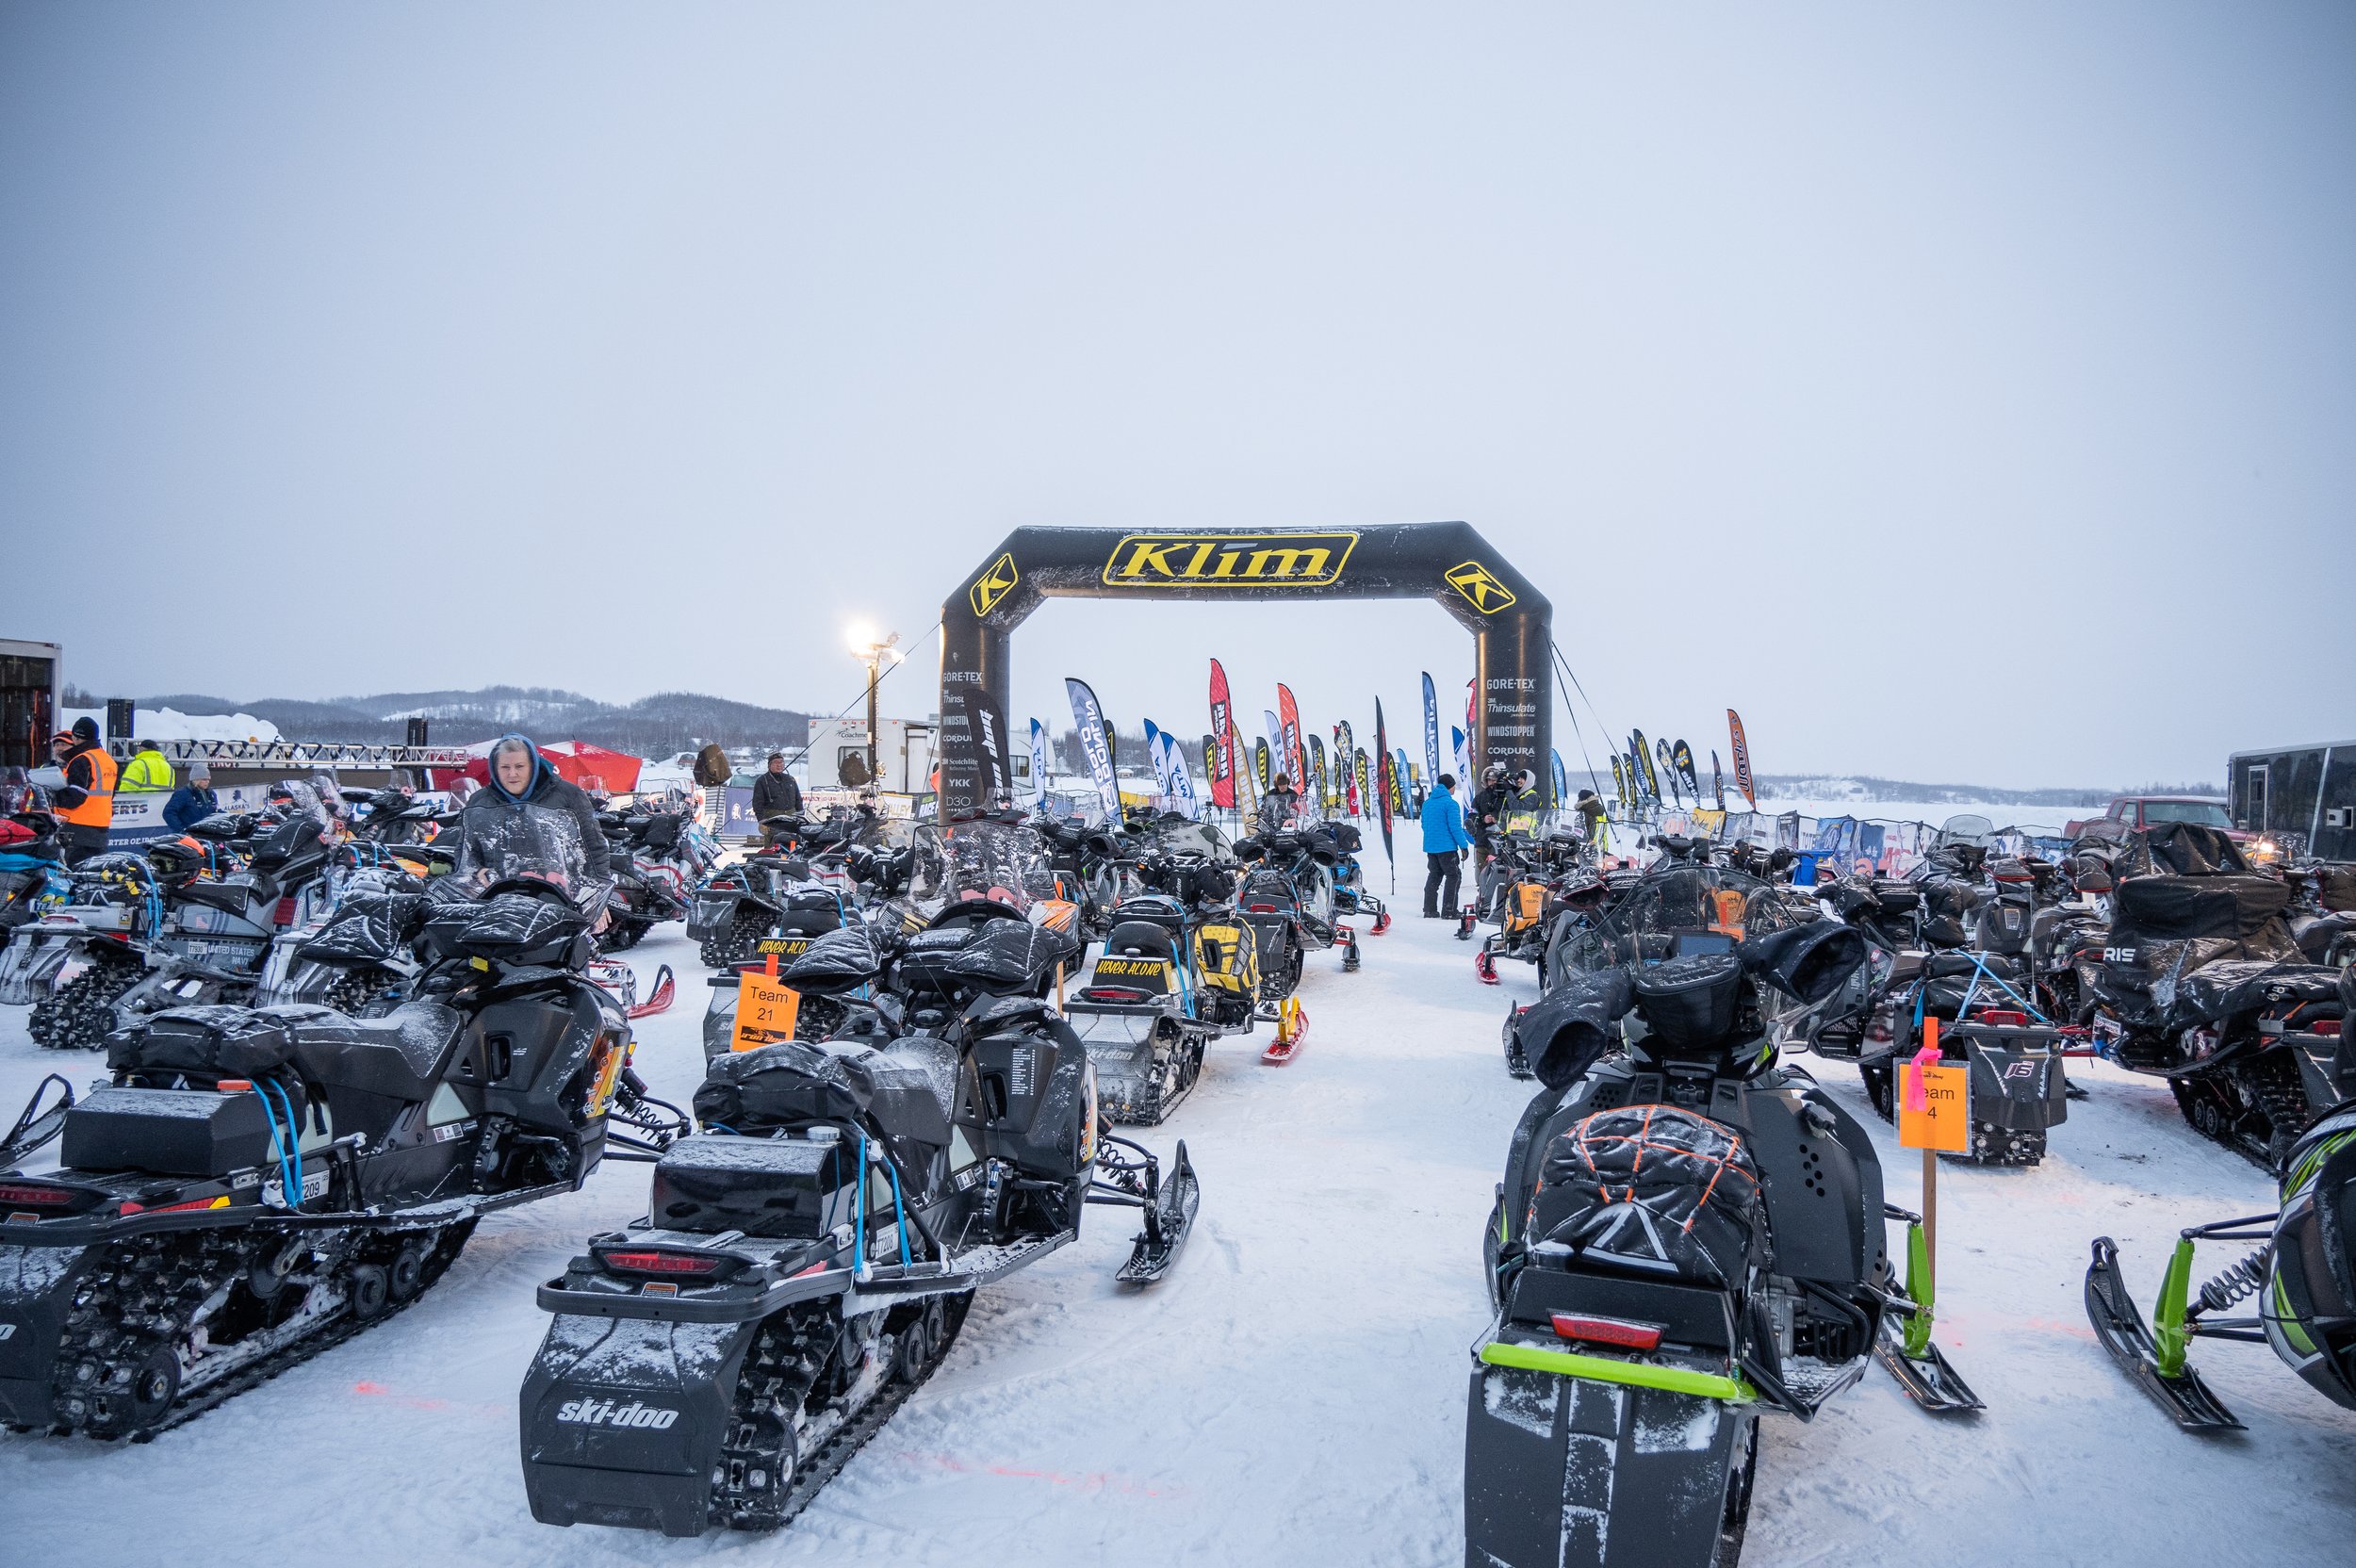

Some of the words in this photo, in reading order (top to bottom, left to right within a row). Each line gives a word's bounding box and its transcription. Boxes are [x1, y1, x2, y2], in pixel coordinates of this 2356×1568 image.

[1118, 542, 1332, 578] Klim
[1486, 678, 1535, 690] GORE-TEX
[1488, 704, 1536, 713] Thinsulate
[1488, 727, 1535, 736] WINDSTOPPER
[1487, 746, 1535, 757] CORDURA
[949, 758, 978, 767] Scotchlite
[949, 778, 971, 787] YKK
[208, 945, 229, 956] UNITED
[231, 947, 254, 957] STATES
[758, 940, 787, 955] NEVER
[788, 941, 807, 954] ALO
[232, 956, 250, 965] NAVY
[1096, 959, 1127, 974] NEVER
[1128, 961, 1161, 976] ALONE
[751, 986, 789, 1004] Team
[757, 1007, 773, 1021] 21
[1924, 1089, 1955, 1100] eam
[1927, 1106, 1938, 1119] 4
[303, 1182, 320, 1199] 209
[557, 1397, 679, 1429] ski-doo
